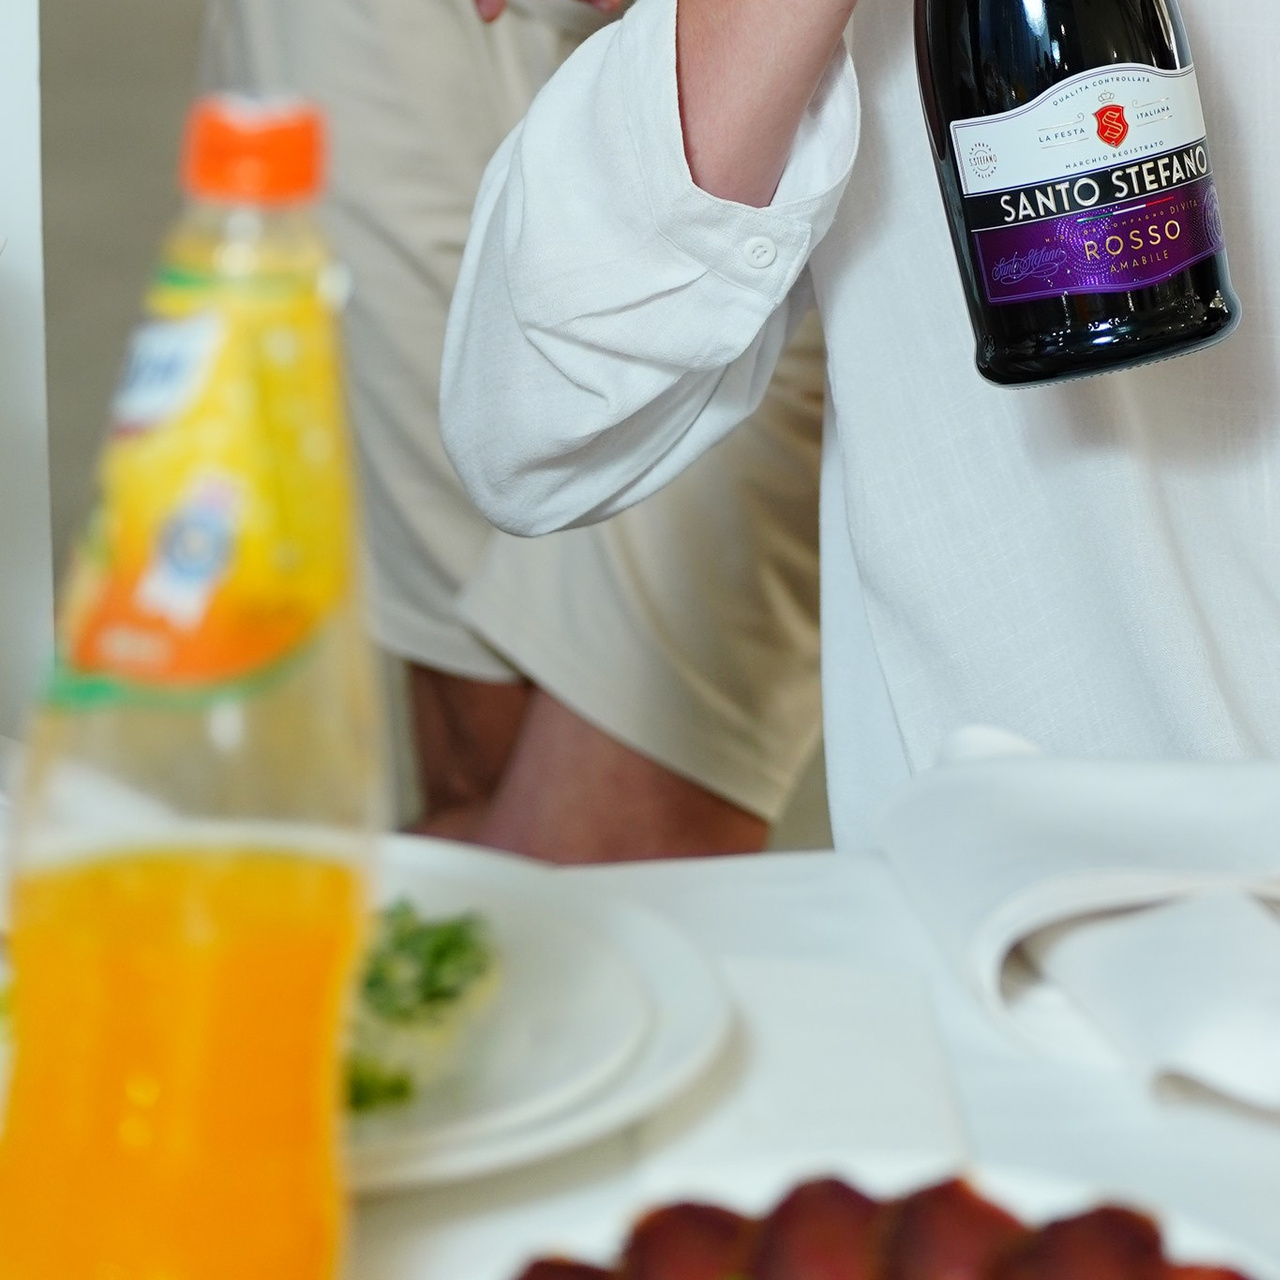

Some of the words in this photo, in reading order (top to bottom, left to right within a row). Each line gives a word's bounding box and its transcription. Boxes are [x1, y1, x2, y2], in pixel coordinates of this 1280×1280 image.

[1092, 76, 1150, 87] CONTROLLATA
[1136, 106, 1170, 120] ITALIANA
[1038, 135, 1051, 143] LA
[1054, 127, 1085, 139] FESTA
[1065, 154, 1108, 169] MARCHIO
[1112, 140, 1164, 158] REGISTRATO
[1000, 177, 1100, 222] SANTO
[1111, 145, 1207, 198] STEFANO
[1084, 220, 1181, 261] ROSSO
[1110, 249, 1169, 273] AMABILE
